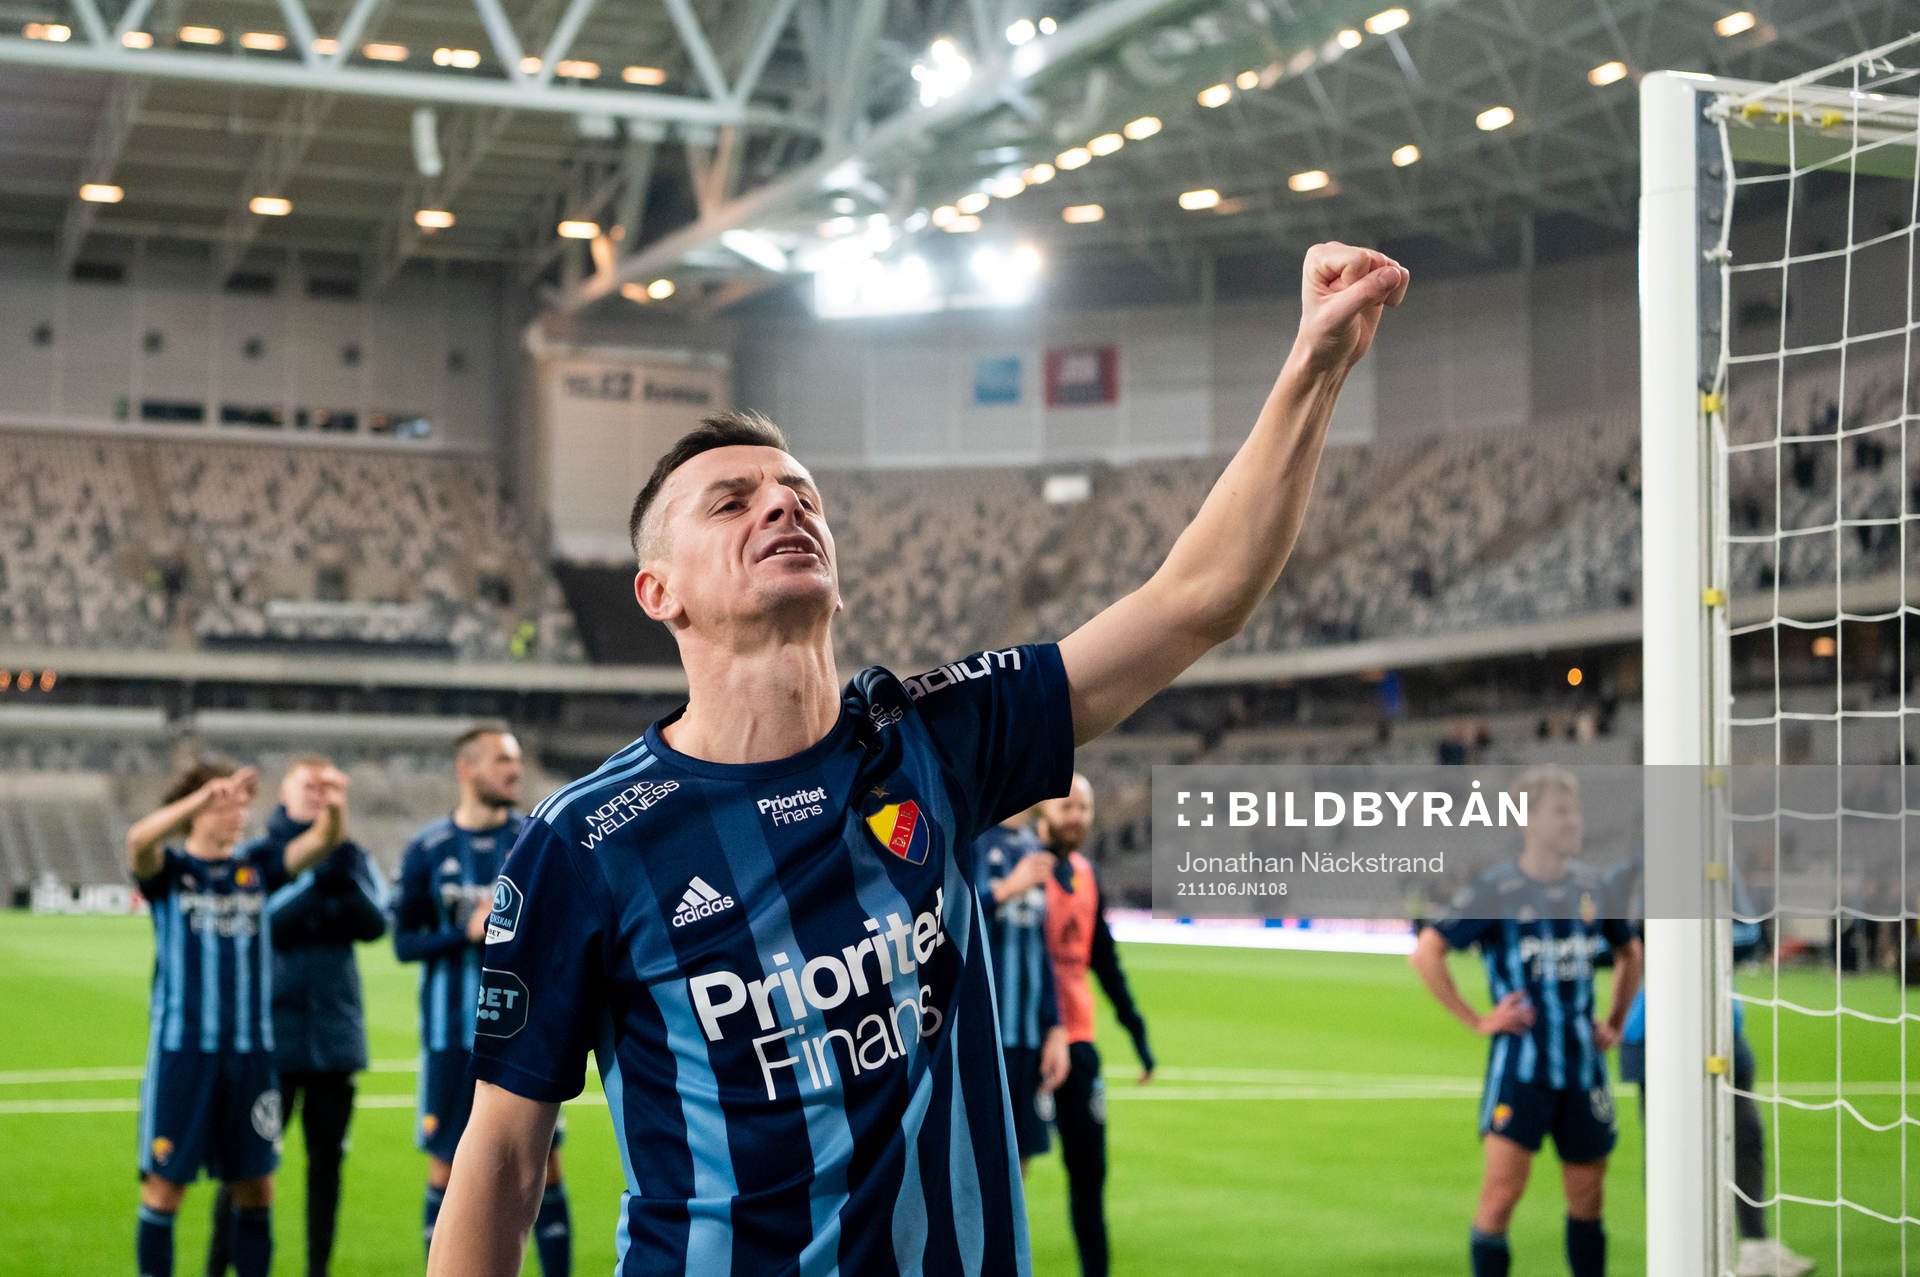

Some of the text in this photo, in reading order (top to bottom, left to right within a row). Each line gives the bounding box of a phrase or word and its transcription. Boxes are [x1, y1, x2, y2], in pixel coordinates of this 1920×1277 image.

[581, 780, 680, 850] WELLNESS
[585, 781, 654, 827] NORDIC
[756, 786, 827, 815] Prioritet
[771, 804, 823, 827] Finans
[672, 894, 735, 928] adidas
[689, 887, 947, 1042] Prioritet
[752, 984, 944, 1102] Finans
